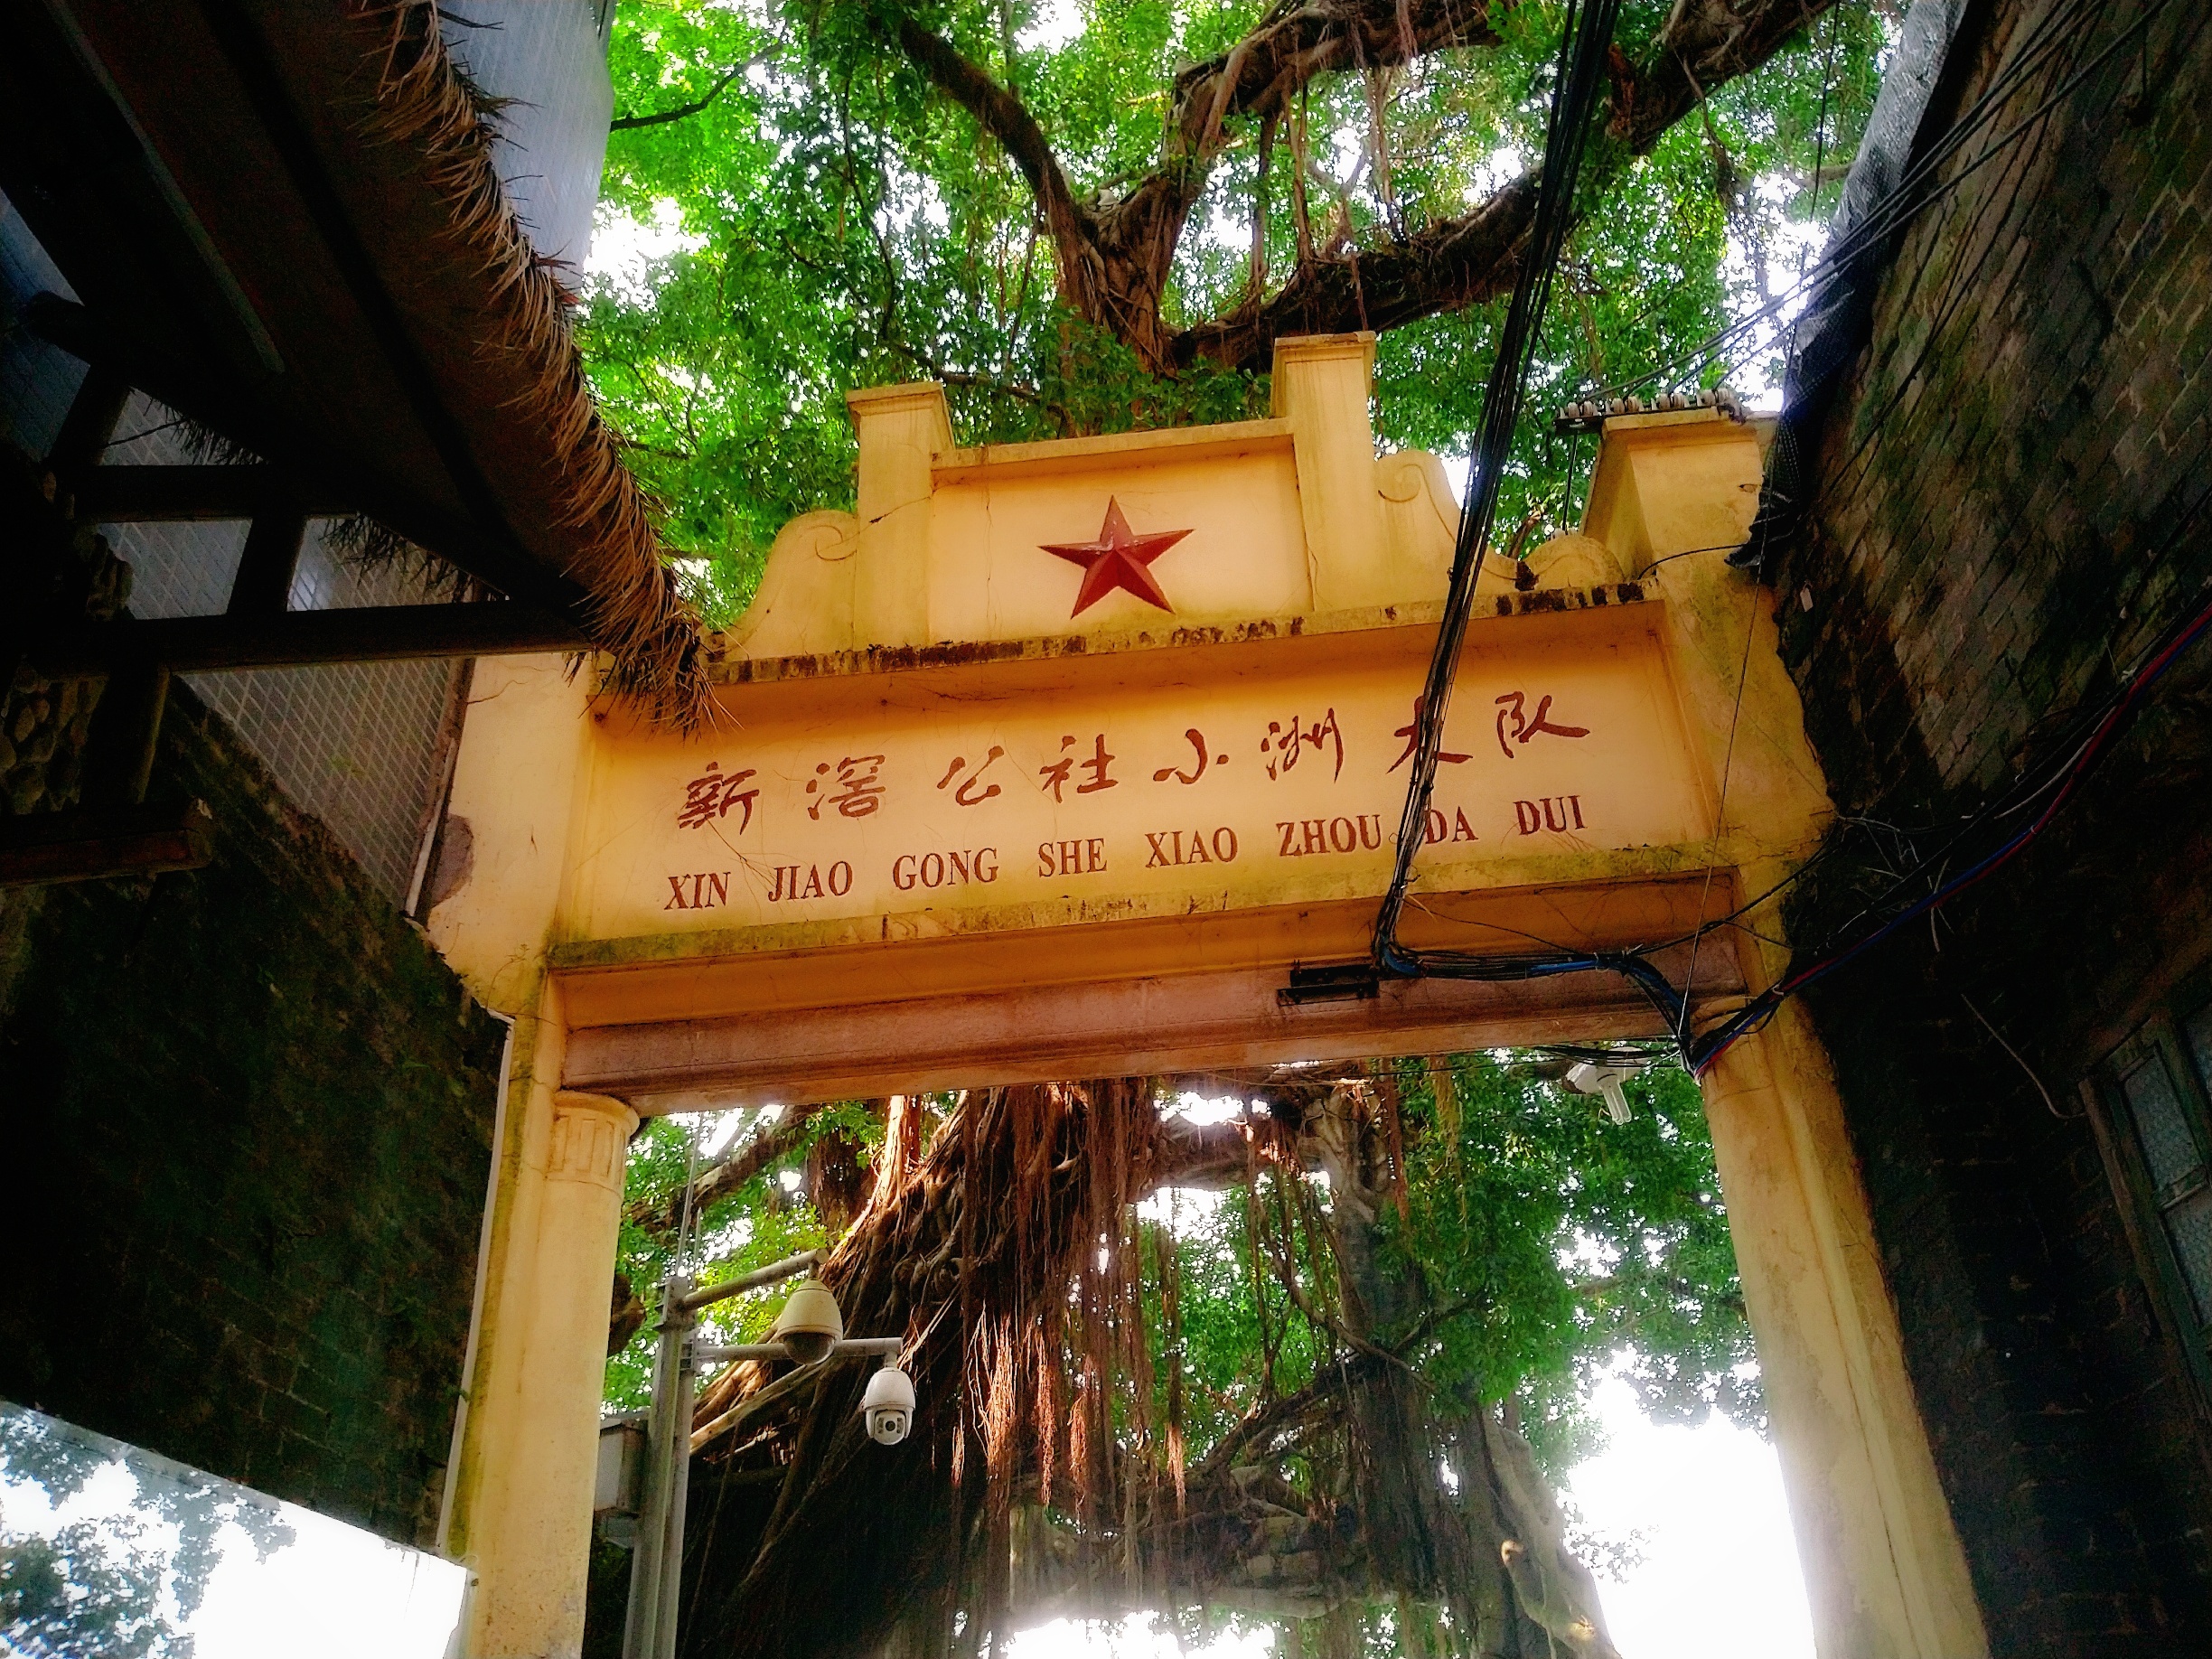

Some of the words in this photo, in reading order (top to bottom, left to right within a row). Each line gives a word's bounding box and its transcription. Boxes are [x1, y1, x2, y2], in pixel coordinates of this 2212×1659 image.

[664, 872, 732, 911] XIN
[767, 860, 853, 902] JIAO
[893, 848, 999, 891] GONG
[1038, 838, 1108, 878] SHE
[1145, 827, 1238, 868] XIAO
[1276, 814, 1382, 858] ZHOU
[1425, 806, 1478, 845] DA
[1513, 795, 1588, 837] DUI
